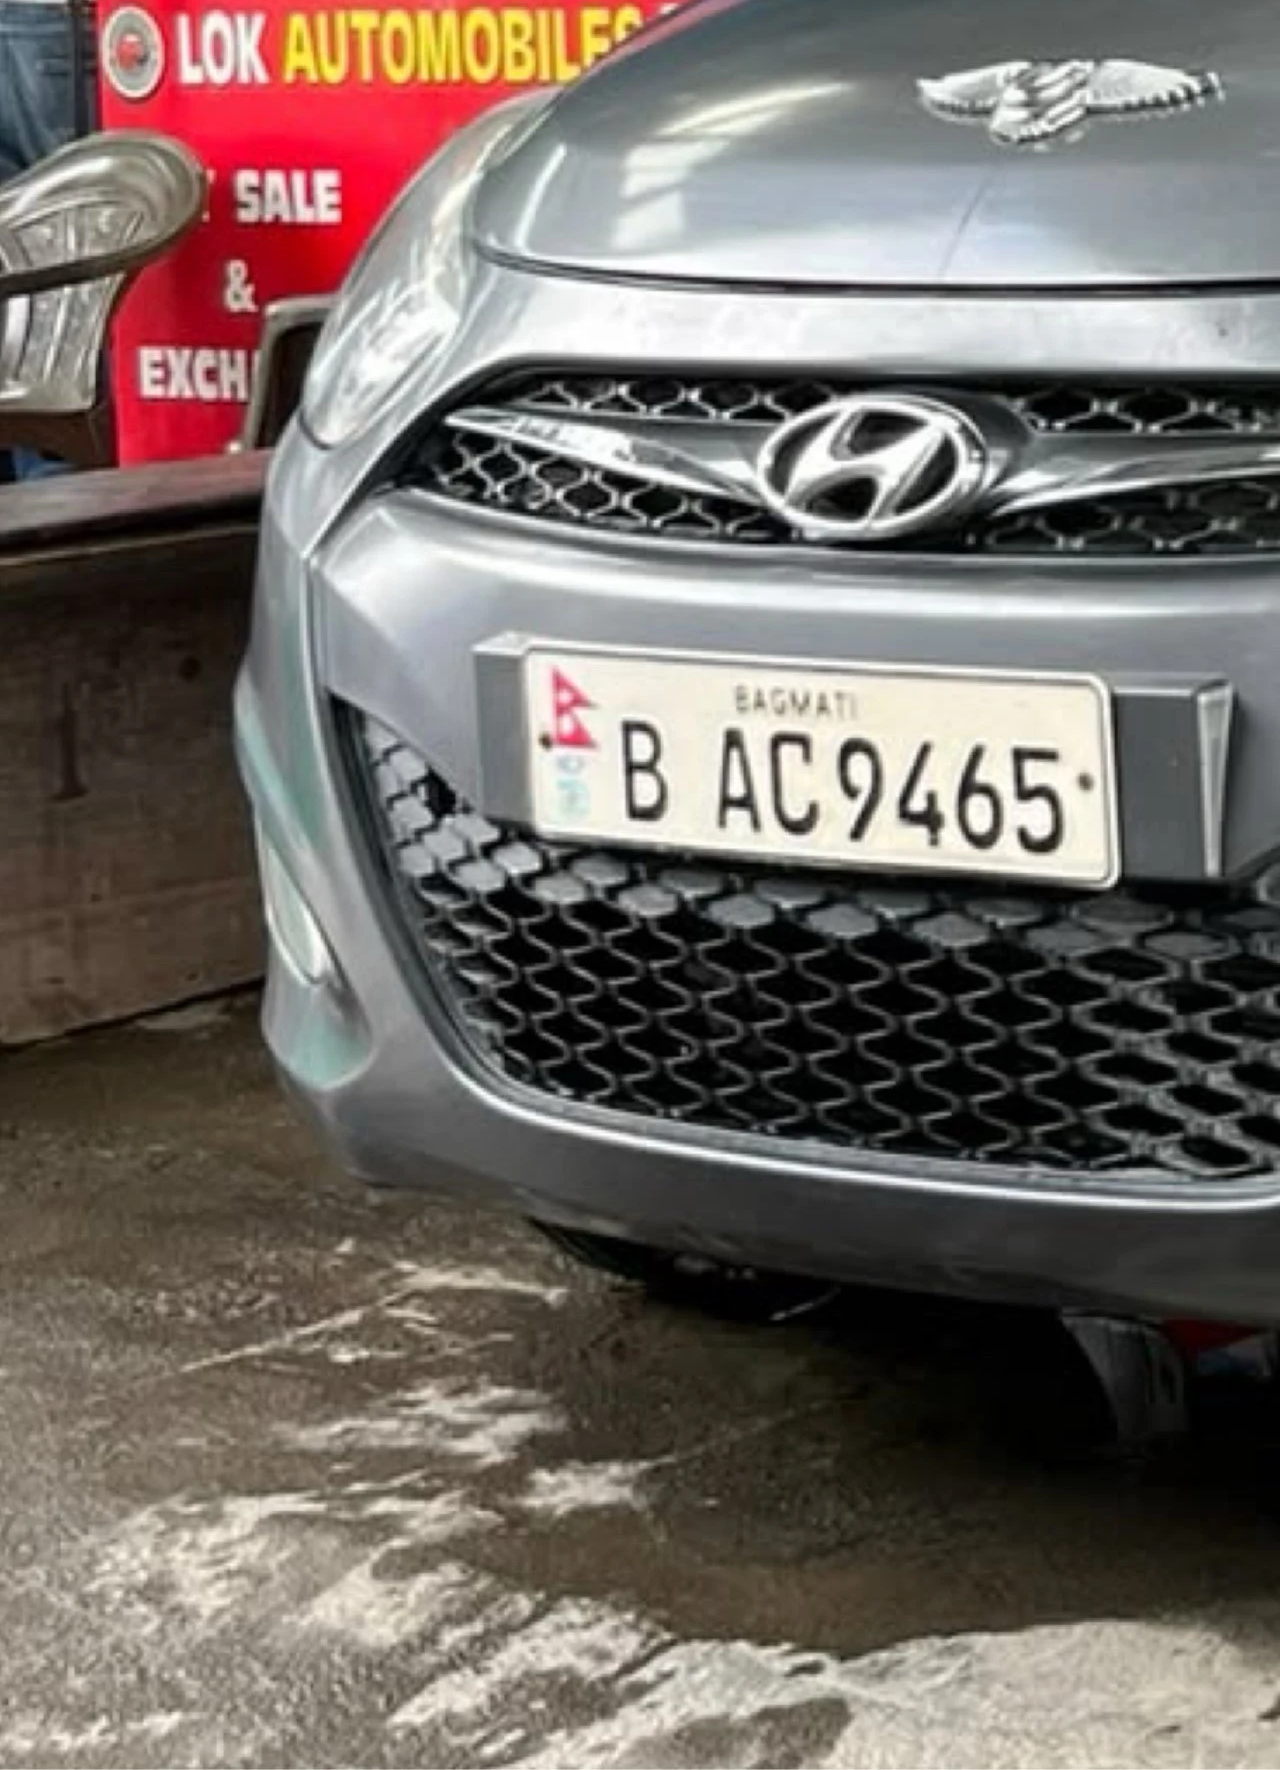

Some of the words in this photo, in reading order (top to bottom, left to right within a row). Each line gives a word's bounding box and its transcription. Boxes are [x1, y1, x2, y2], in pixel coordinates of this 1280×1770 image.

[177, 13, 271, 86] LOK
[234, 169, 342, 224] SALE
[223, 259, 256, 313] &
[734, 684, 860, 722] BAGMATI
[621, 720, 668, 822] B
